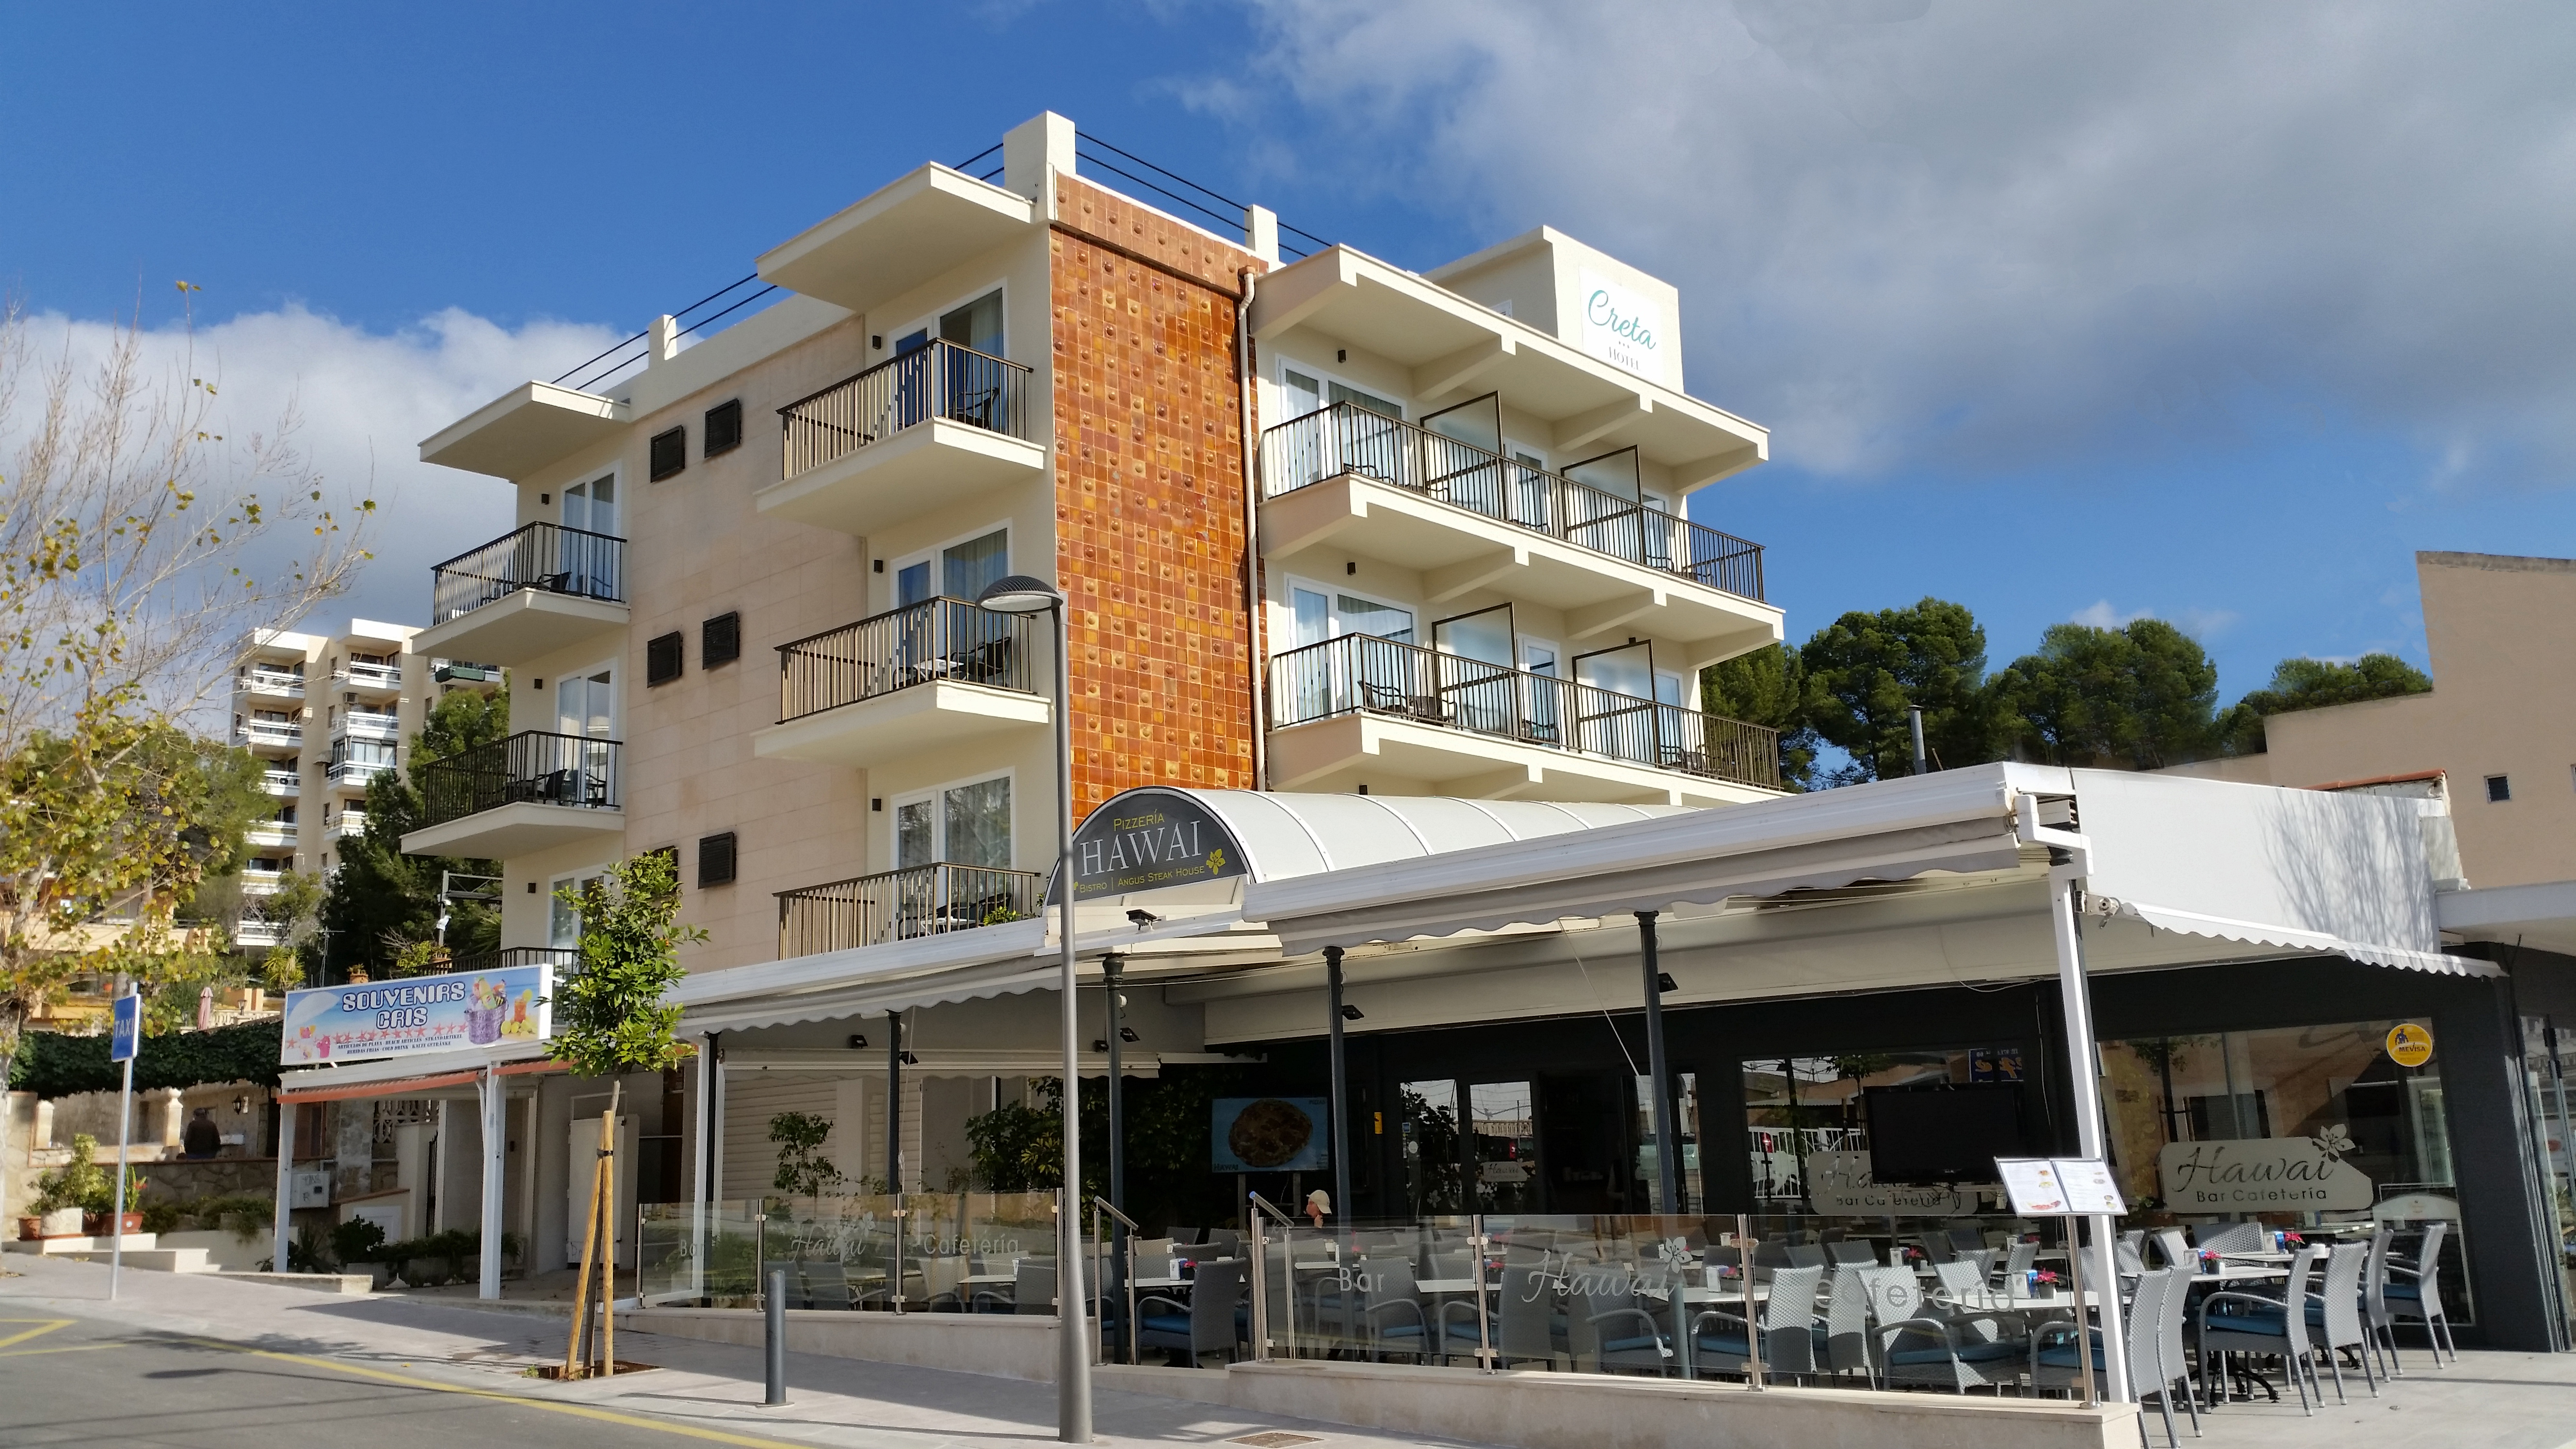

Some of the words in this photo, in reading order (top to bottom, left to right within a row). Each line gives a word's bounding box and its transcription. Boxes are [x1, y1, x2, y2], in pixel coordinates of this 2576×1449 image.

[1588, 290, 1656, 349] Creta
[1609, 347, 1641, 370] HOTEL
[1080, 820, 1202, 877] HAWAI
[342, 982, 466, 1012] SOUVENIRS
[114, 1018, 135, 1038] TAXI
[376, 1007, 427, 1029] CRIS
[2399, 1042, 2426, 1052] MEVISA
[2172, 1146, 2334, 1192] Hawai
[1836, 1195, 1859, 1206] Bar
[2197, 1190, 2225, 1202] Bar
[2233, 1187, 2327, 1202] Cafetería
[680, 1239, 705, 1257] Bar
[787, 1224, 867, 1263] Hawai
[923, 1233, 1019, 1255] Cafetería
[1339, 1266, 1385, 1293] Bar
[1521, 1248, 1677, 1304] Hawai
